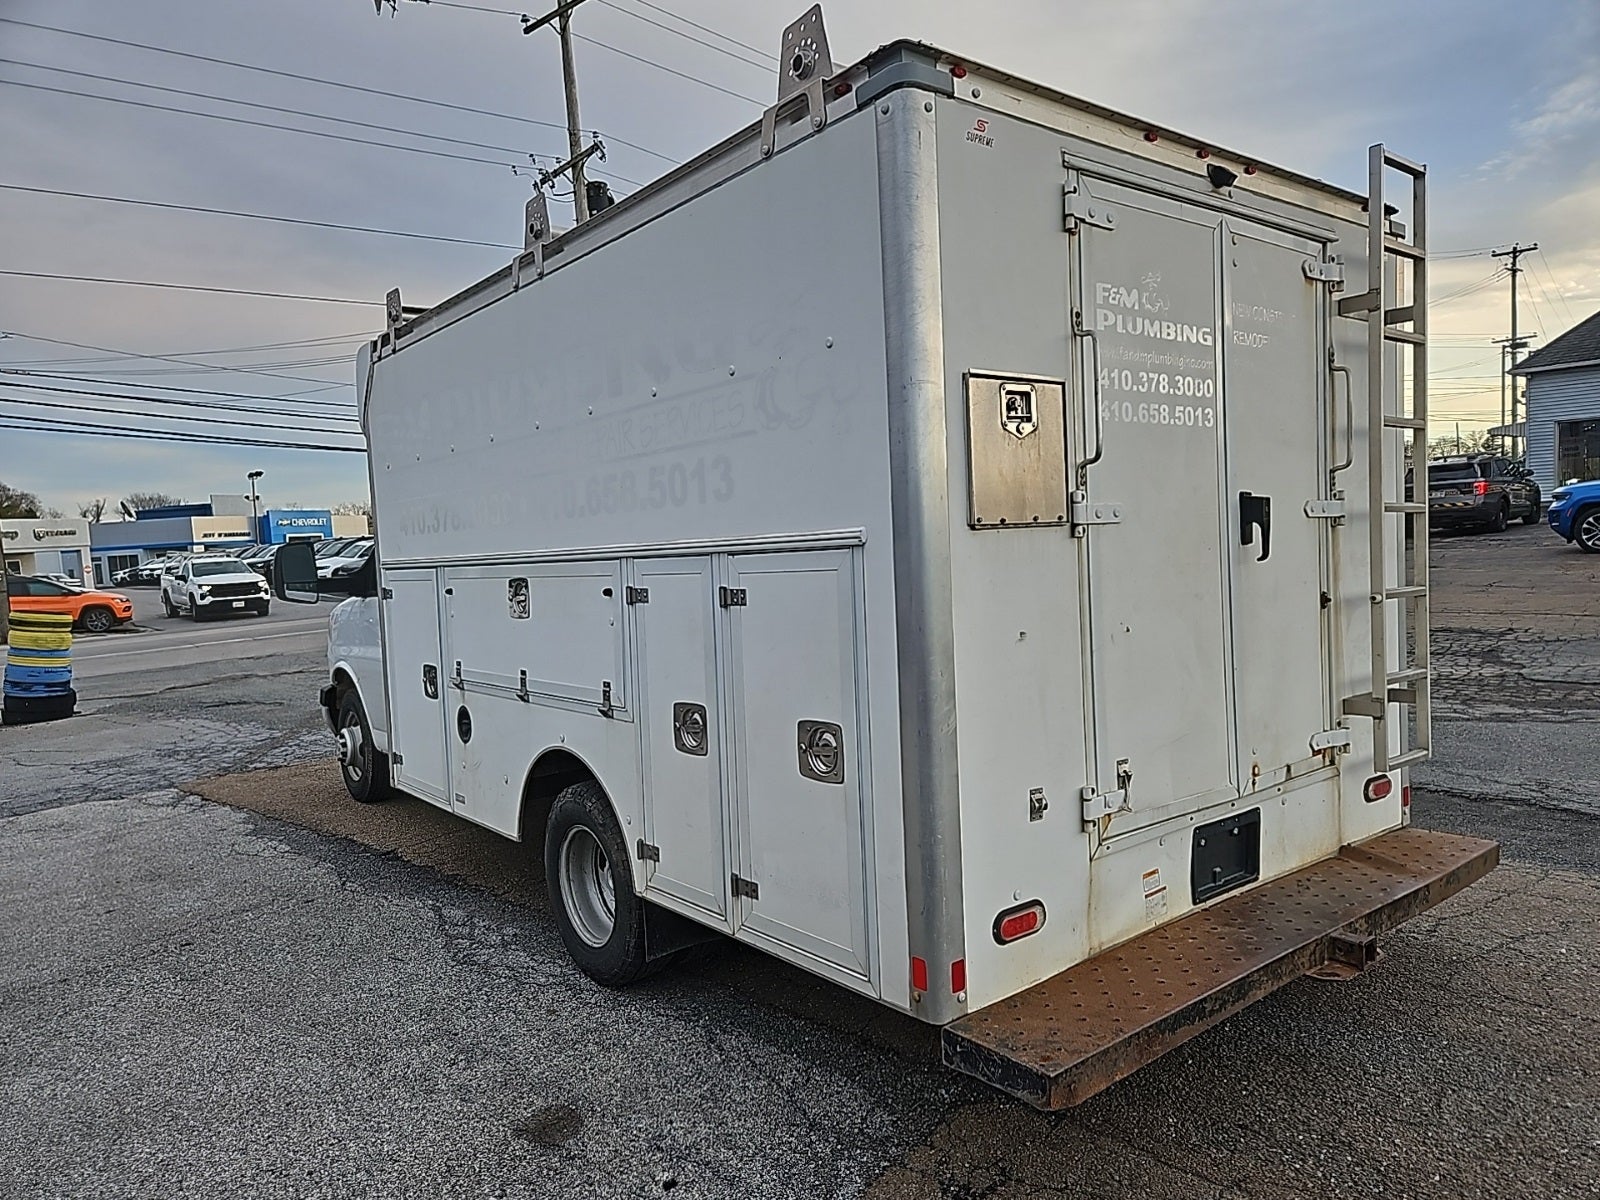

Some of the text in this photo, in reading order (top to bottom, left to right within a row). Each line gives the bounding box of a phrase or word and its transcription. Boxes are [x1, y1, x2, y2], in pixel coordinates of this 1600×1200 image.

[965, 131, 994, 147] SUPREME
[1095, 282, 1139, 310] F&M
[1096, 309, 1213, 346] PLUMBING
[1100, 367, 1214, 398] 410.378.3000
[639, 389, 746, 449] SERVICES
[1101, 399, 1214, 428] 410.658.5013
[291, 517, 327, 527] CHEVROLET
